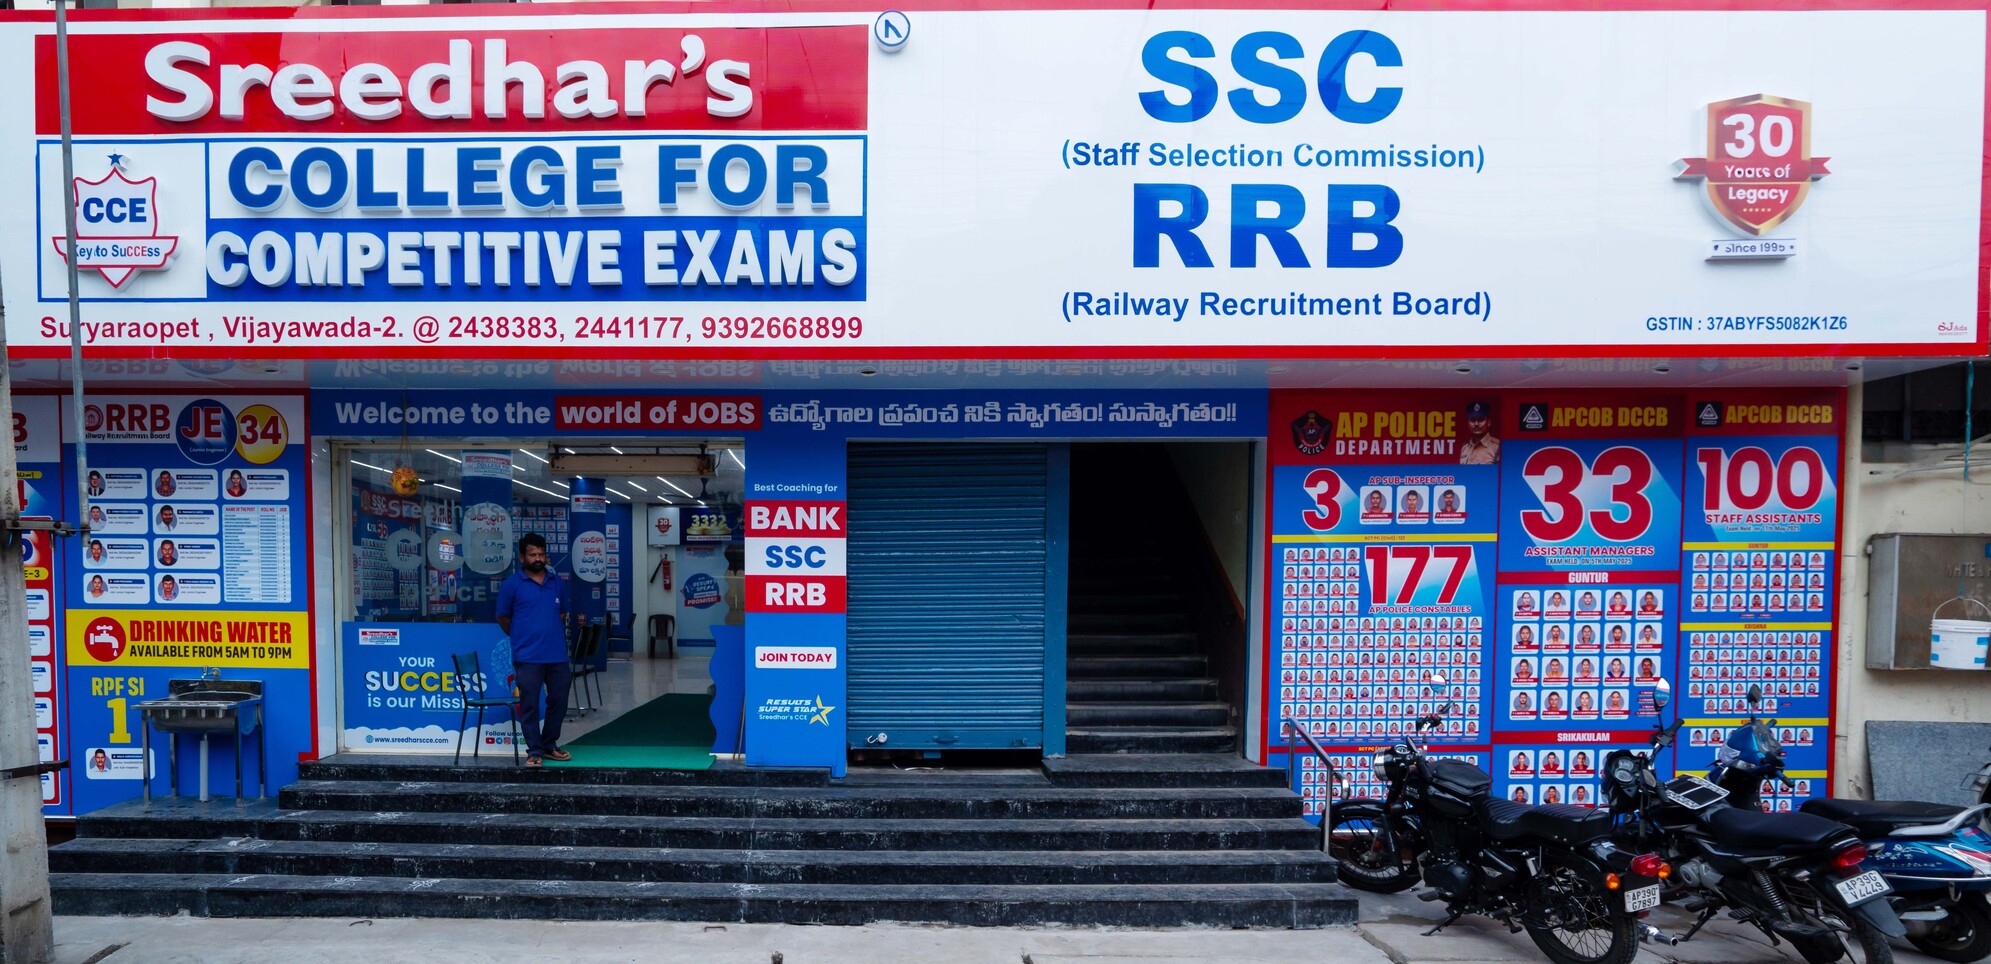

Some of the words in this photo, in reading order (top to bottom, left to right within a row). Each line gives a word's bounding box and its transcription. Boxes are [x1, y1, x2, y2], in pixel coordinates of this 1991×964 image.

[144, 34, 753, 121] Sreedhar's
[1138, 29, 1404, 124] SSC
[1722, 113, 1794, 158] 30
[1062, 139, 1140, 169] (Staff
[1149, 142, 1283, 167] Selection
[1293, 143, 1485, 173] Commission)
[228, 145, 624, 212] COLLEGE
[658, 144, 829, 210] FOR
[1725, 165, 1771, 178] Years
[1774, 164, 1791, 178] of
[1728, 187, 1789, 204] Legacy
[83, 197, 147, 223] CCE
[1133, 183, 1404, 268] RRB
[206, 230, 623, 287] COMPETITIVE
[643, 228, 858, 287] EXAMS
[1062, 291, 1189, 322] (Railway
[1200, 291, 1382, 316] Recruitment
[1392, 291, 1491, 322] Board)
[222, 316, 403, 343] Vijayawada-2.
[413, 316, 440, 344] @
[448, 316, 565, 342] 2438383,
[575, 316, 691, 342] 2441177,
[701, 316, 863, 339] 9392668899
[1646, 317, 1693, 331] GSTIN
[1707, 316, 1848, 331] 37ABYFS5082K1Z6
[106, 404, 170, 432] RRB
[180, 406, 222, 438] JE
[335, 402, 465, 423] Welcome
[471, 402, 499, 423] to
[504, 402, 551, 423] the
[561, 401, 641, 423] world
[649, 400, 677, 423] of
[682, 402, 755, 423] JOBS
[1552, 407, 1614, 427] APCOB
[1618, 407, 1668, 427] DCCB
[1725, 405, 1782, 424] APCOB
[1786, 405, 1833, 424] DCCB
[85, 432, 105, 440] ilway
[240, 414, 282, 444] 34
[1336, 411, 1368, 438] AP
[1373, 411, 1456, 438] POLICE
[1335, 439, 1456, 455] DEPARTMENT
[754, 484, 775, 492] Best
[776, 484, 823, 494] Coaching
[824, 483, 838, 492] for
[1369, 475, 1381, 485] AP
[1382, 475, 1455, 485] SUB-INSPECTOR
[1697, 445, 1823, 511] 100
[1302, 468, 1342, 531] 3
[1520, 445, 1653, 542] 33
[751, 506, 841, 531] BANK
[1705, 514, 1743, 524] STAFF
[1746, 513, 1822, 524] ASSISTANTS
[765, 545, 826, 569] SSC
[1525, 546, 1588, 556] ASSISTANT
[1589, 546, 1655, 556] MANAGERS
[1365, 545, 1473, 605] 177
[1568, 571, 1609, 583] GUNTUR
[1945, 562, 1975, 577] WHTE
[765, 582, 827, 606] RRB
[1368, 605, 1381, 614] AP
[1382, 605, 1412, 613] POLICE
[1414, 605, 1472, 613] CONSTABLES
[130, 620, 223, 643] DRINKING
[227, 621, 292, 644] WATER
[130, 645, 191, 658] AVAILABLE
[192, 645, 223, 658] FROM
[225, 646, 250, 659] 5AM
[253, 647, 266, 659] TO
[268, 647, 292, 659] 9PM
[399, 657, 435, 668] YOUR
[760, 653, 788, 662] JOIN
[790, 653, 833, 663] TODAY
[91, 677, 125, 696] RPF
[128, 677, 145, 696] SI
[365, 671, 488, 692] SUCCESS
[367, 693, 382, 708] is
[386, 695, 416, 708] our
[421, 693, 488, 709] Missi
[107, 698, 131, 743] 1
[374, 736, 449, 744] www.sreedharscce.com
[1557, 732, 1611, 742] SRIKAKULAM
